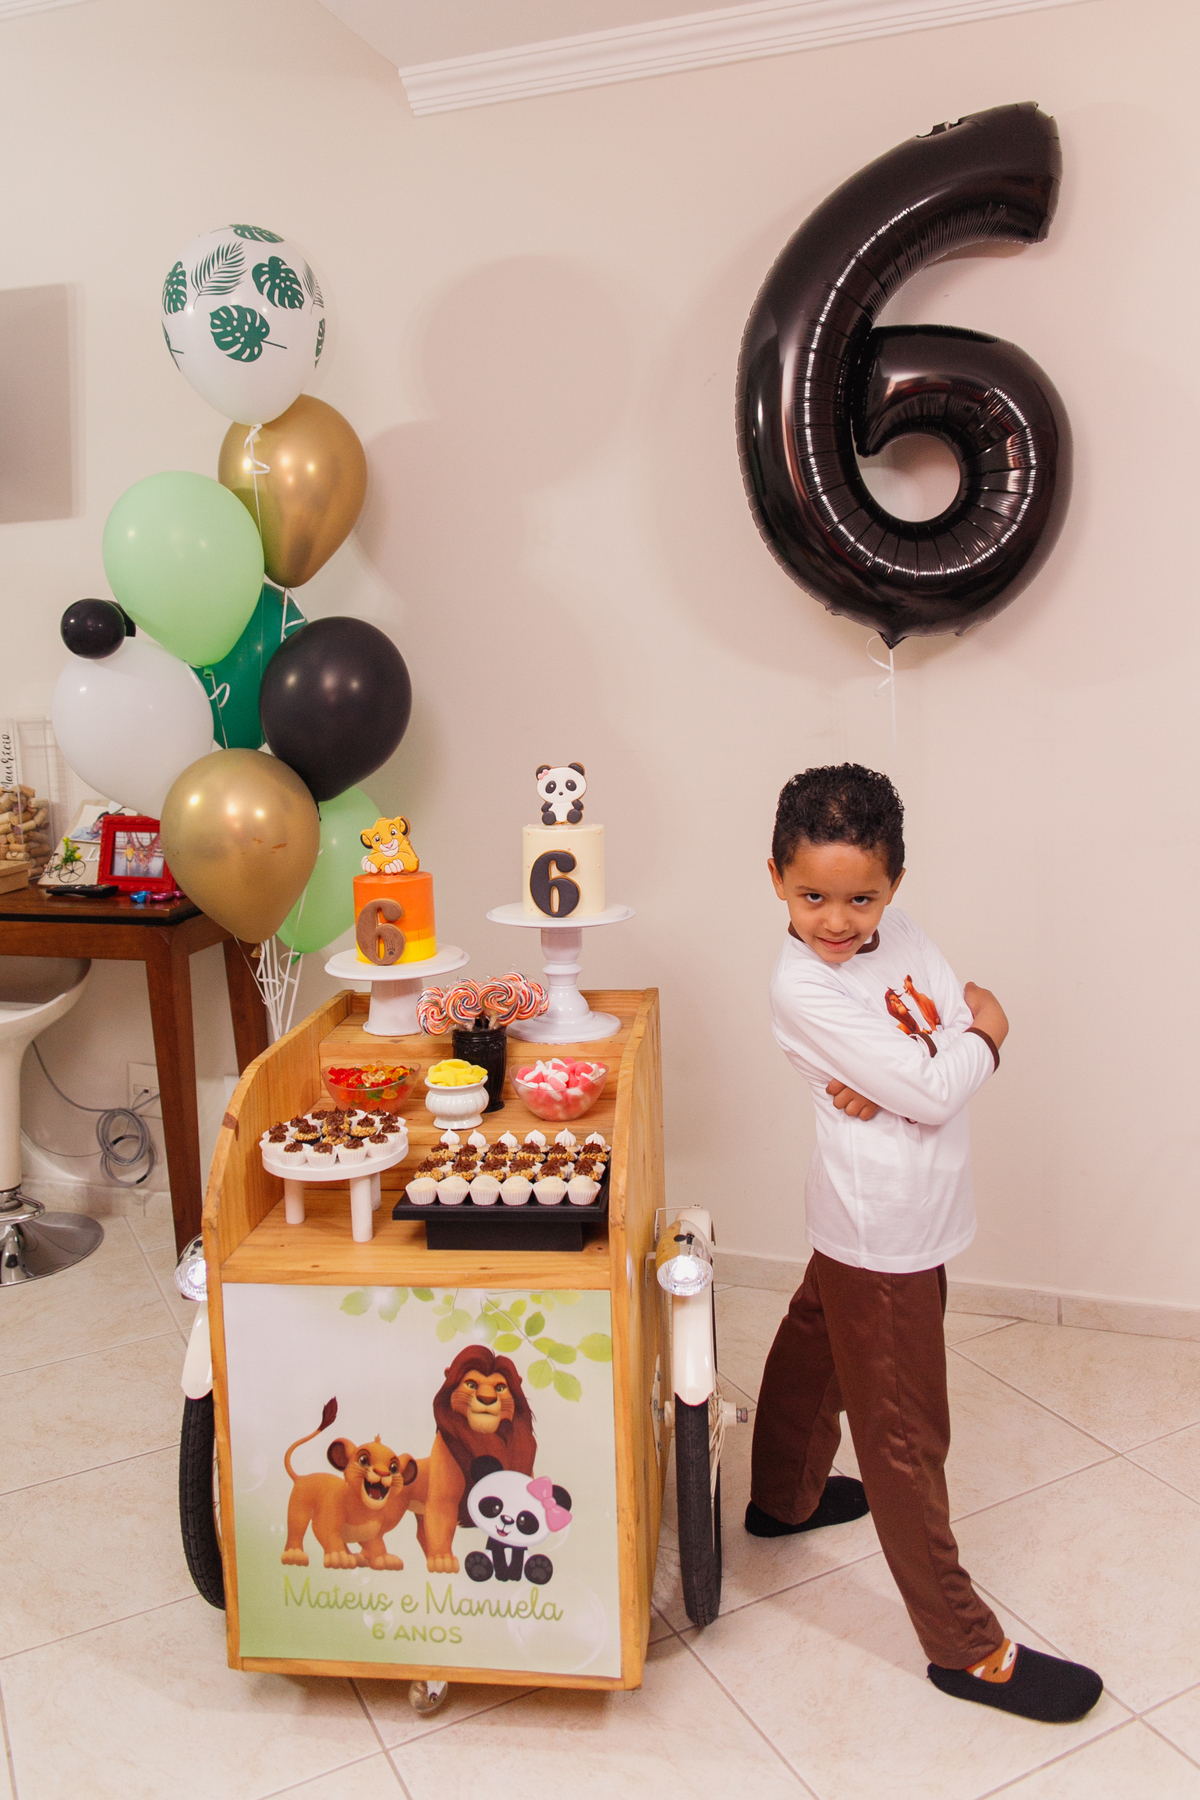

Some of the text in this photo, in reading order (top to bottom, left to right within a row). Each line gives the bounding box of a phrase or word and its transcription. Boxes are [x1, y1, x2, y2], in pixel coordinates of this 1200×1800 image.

[736, 101, 1073, 649] 6
[530, 850, 580, 918] 6
[356, 898, 406, 966] 6
[283, 1574, 564, 1622] Mateus e Manuela
[371, 1623, 463, 1644] 6 ANOS
